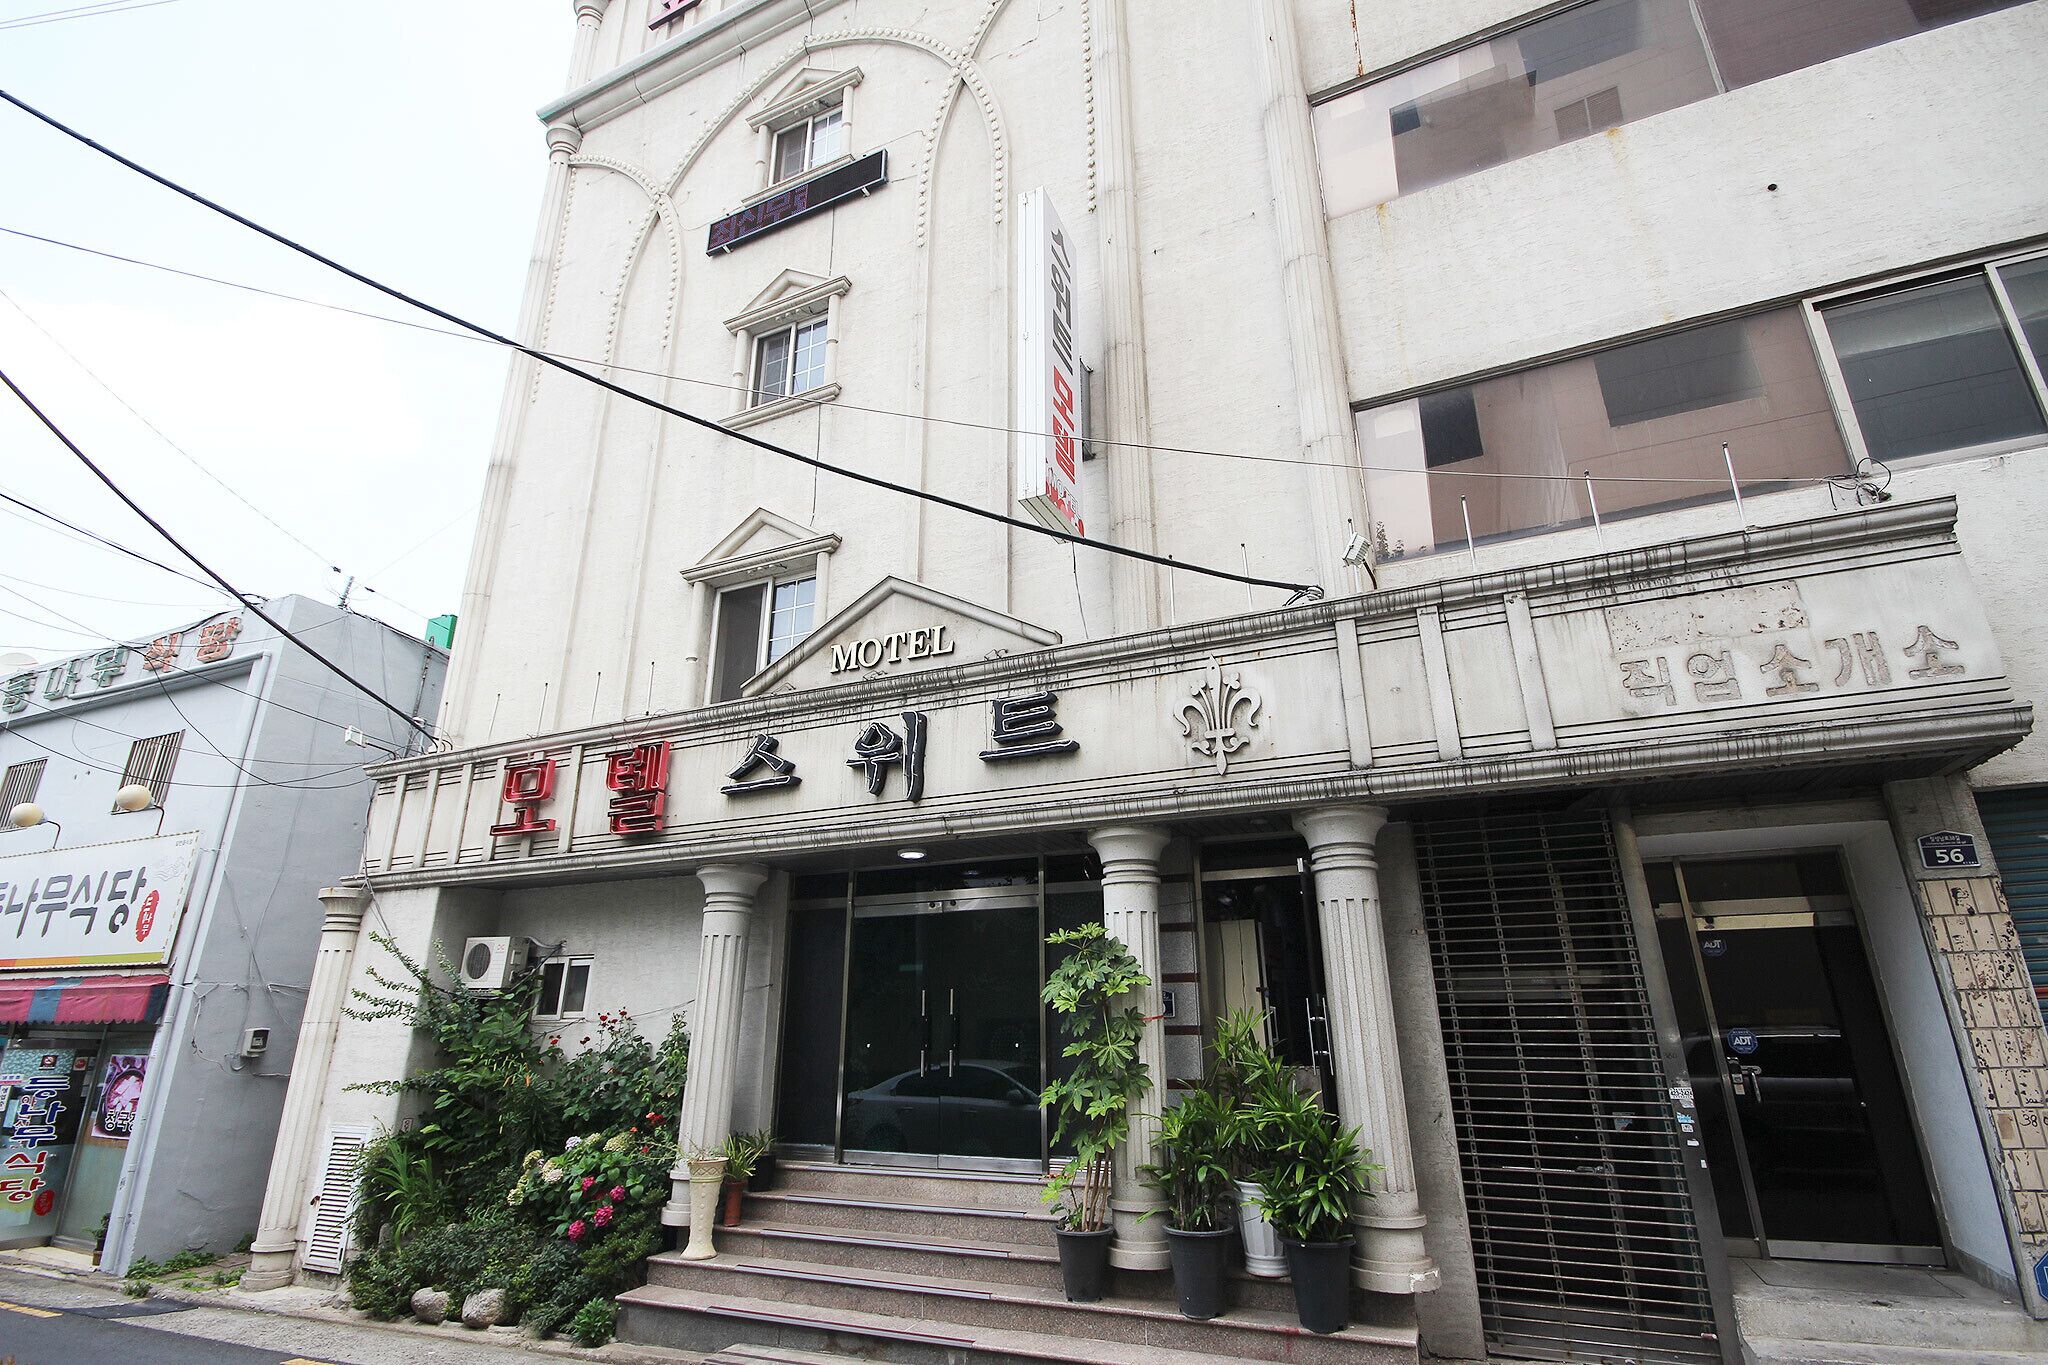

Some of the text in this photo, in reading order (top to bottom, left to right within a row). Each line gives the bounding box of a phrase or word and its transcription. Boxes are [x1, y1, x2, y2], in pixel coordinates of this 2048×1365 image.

[1053, 365, 1076, 486] 모텔
[829, 625, 955, 674] MOTEL
[1619, 625, 1966, 707] 직업소개소
[490, 690, 1081, 837] 모텔 스위트
[1935, 848, 1965, 863] 56
[1704, 940, 1721, 949] ADT
[1733, 1036, 1752, 1046] ADT
[0, 1076, 71, 1203] 등나무식당
